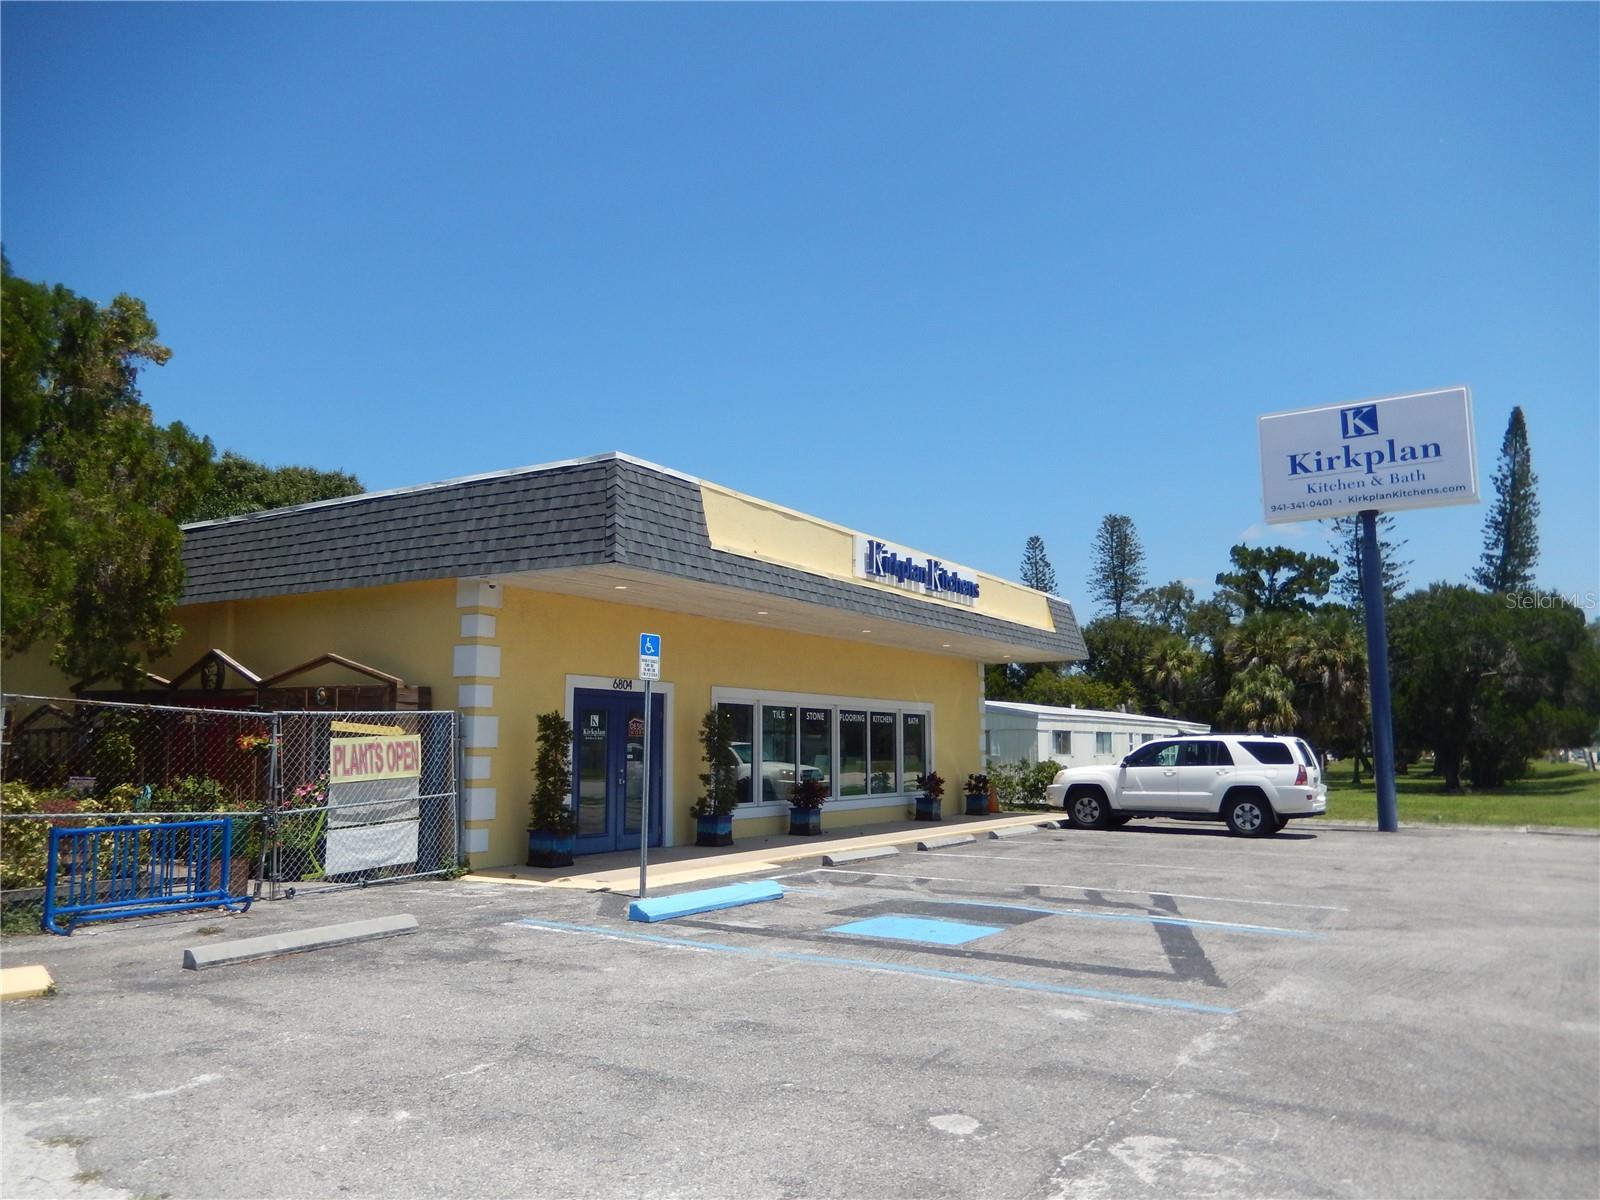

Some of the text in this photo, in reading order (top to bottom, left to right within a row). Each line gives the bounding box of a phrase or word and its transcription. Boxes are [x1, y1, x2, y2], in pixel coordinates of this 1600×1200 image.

[1343, 406, 1378, 437] K
[1287, 439, 1443, 476] Kirkplan
[1306, 469, 1427, 495] Kitchen & Bath
[1270, 483, 1467, 513] 941-341-0401 KirkplanKitchens.com
[865, 540, 980, 598] Kirkplan Kitchens
[612, 679, 633, 690] 6804
[772, 710, 786, 719] TILE
[806, 711, 825, 721] STONE
[839, 714, 865, 722] FLOORING
[872, 715, 893, 724] KITCHEN
[333, 741, 419, 776] PLANTS OPEN
